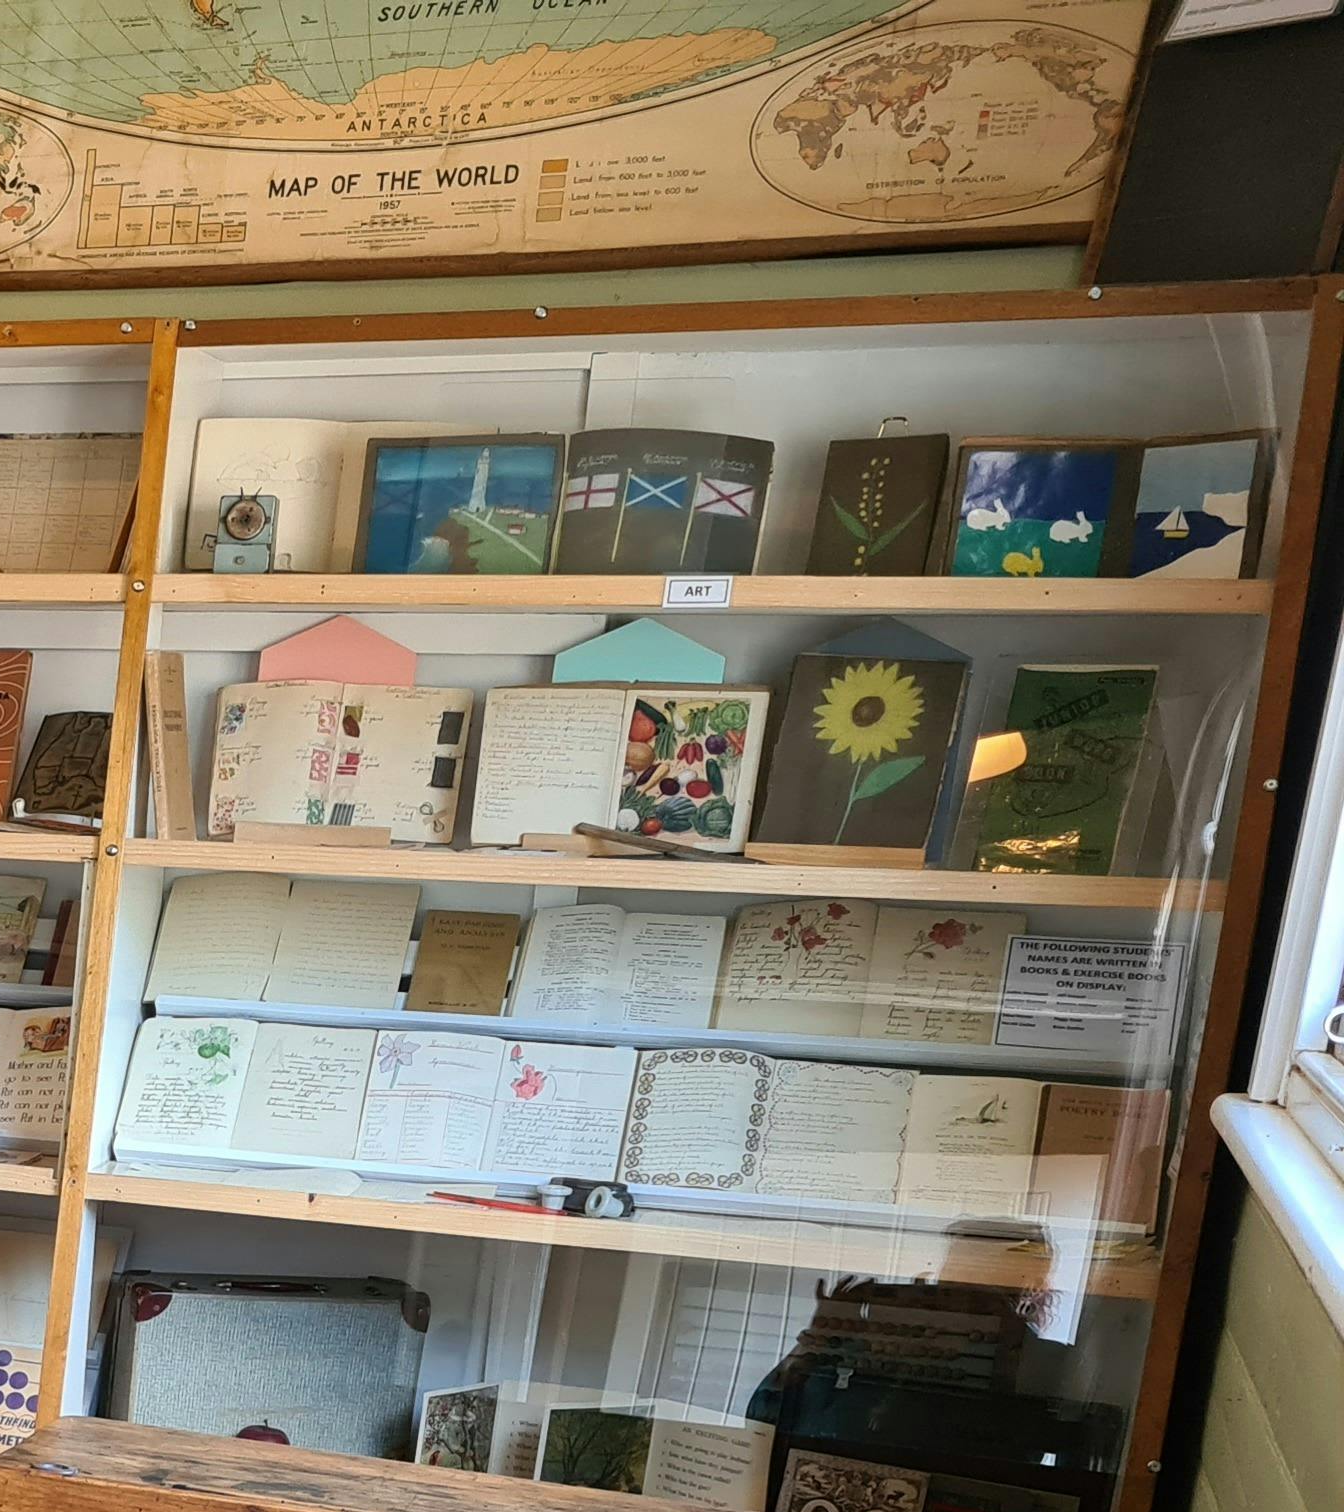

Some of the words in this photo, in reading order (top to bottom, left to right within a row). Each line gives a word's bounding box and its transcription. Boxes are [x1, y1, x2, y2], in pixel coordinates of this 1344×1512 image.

[347, 112, 487, 133] ANTARCTICA
[268, 176, 318, 198] MAP
[331, 174, 361, 194] OF
[376, 170, 421, 191] THE
[436, 164, 520, 188] WORLD
[866, 179, 926, 190] DISTRIBUTION
[379, 200, 402, 210] 1957
[685, 585, 712, 597] ART
[1043, 942, 1110, 953] FOLLOWING
[1027, 954, 1068, 964] NAMES
[1071, 956, 1093, 965] ARE
[1096, 958, 1147, 968] WRITTEN
[1020, 967, 1058, 976] BOOKS
[1062, 968, 1071, 976] &
[1074, 969, 1124, 980] EXERCISE
[1056, 980, 1073, 989] ON
